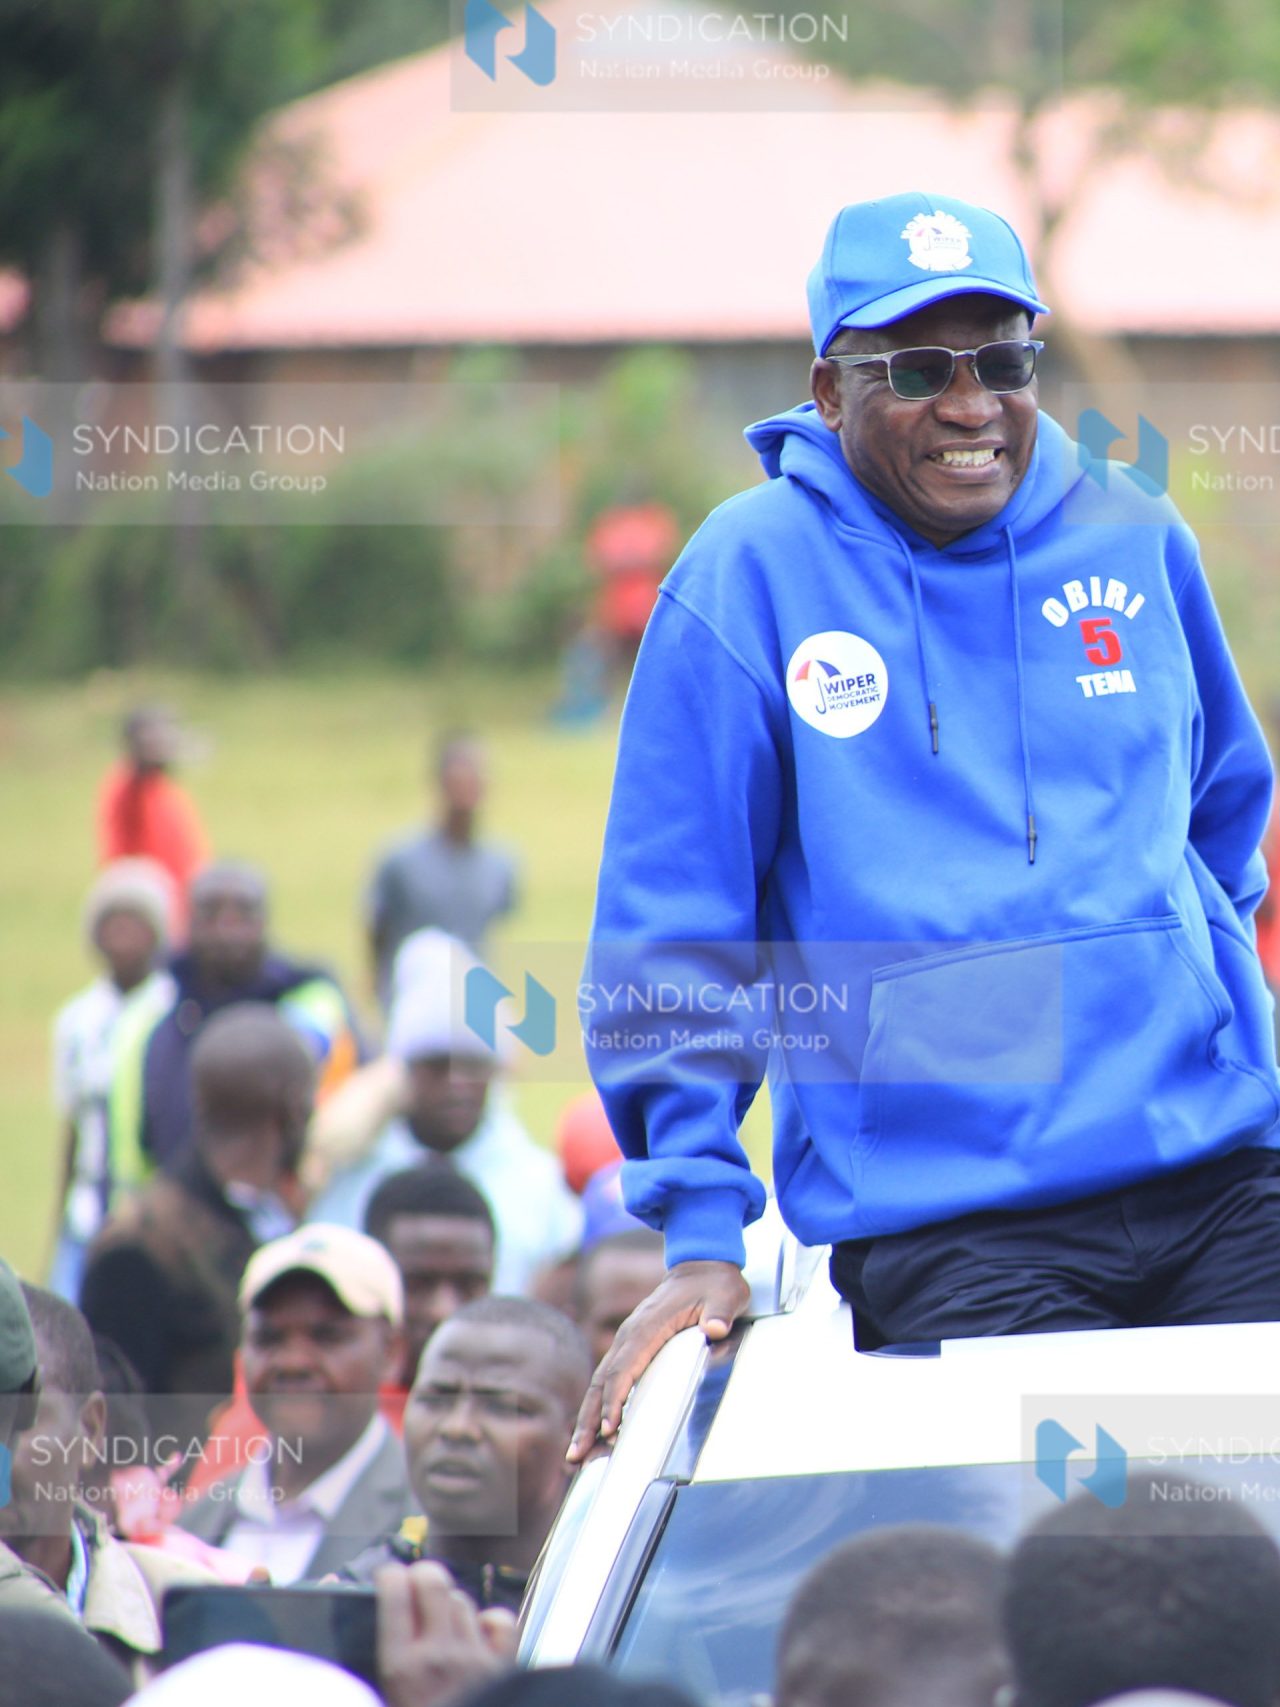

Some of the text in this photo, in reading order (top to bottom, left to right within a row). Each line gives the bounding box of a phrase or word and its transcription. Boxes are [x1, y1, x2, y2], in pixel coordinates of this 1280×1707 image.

[1041, 575, 1147, 629] OBIRI
[1079, 616, 1123, 667] 5
[823, 673, 877, 695] WIPER
[826, 685, 879, 703] DEMOCRATIC
[1075, 669, 1137, 699] TENA
[828, 693, 881, 711] MOVEMENT
